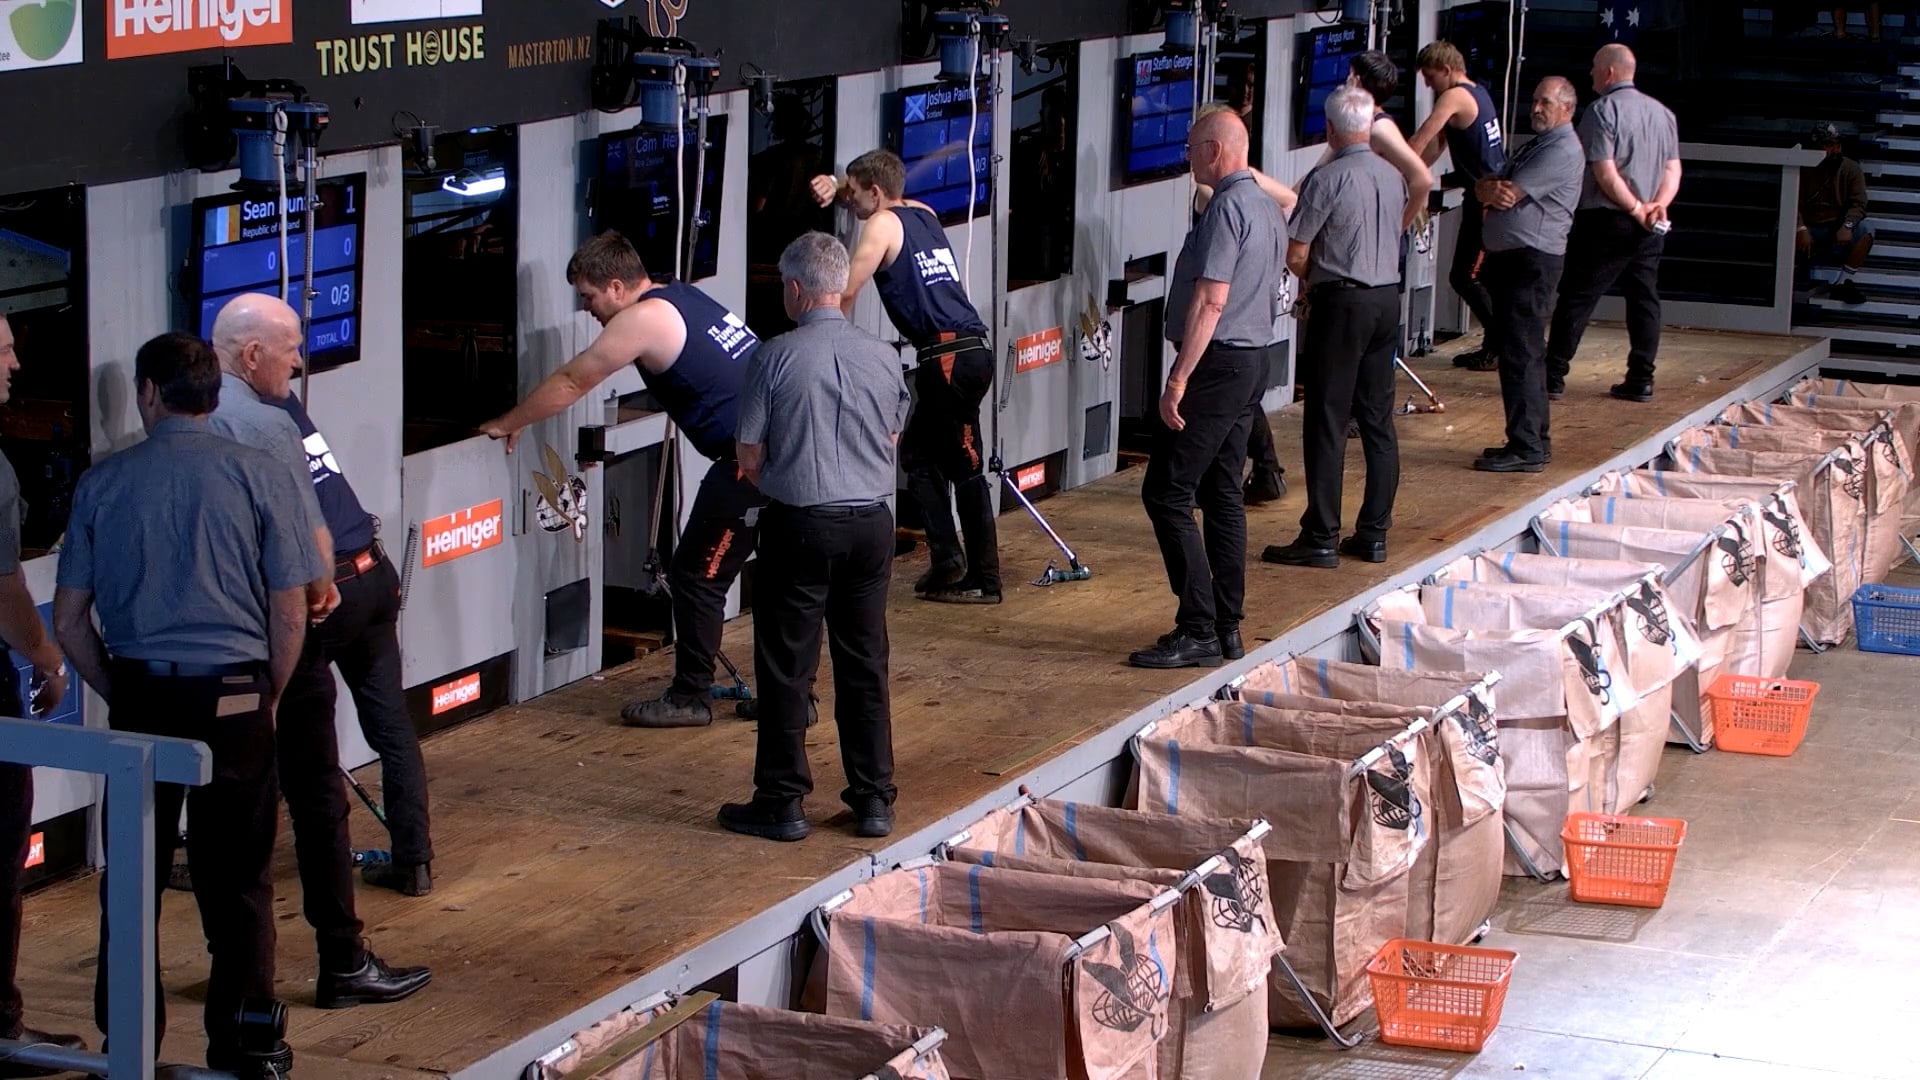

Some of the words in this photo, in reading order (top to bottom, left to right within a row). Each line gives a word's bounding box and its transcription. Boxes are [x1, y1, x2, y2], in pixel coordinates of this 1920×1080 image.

[114, 0, 280, 41] Heiniger
[315, 34, 396, 76] TRUST
[406, 25, 485, 66] HOUSE
[508, 35, 592, 69] MASTERTON.NZ
[1173, 54, 1193, 70] George
[926, 87, 951, 108] Joshua
[953, 86, 979, 103] Paintr
[635, 135, 657, 153] Cam
[975, 156, 986, 174] 0/3
[243, 199, 275, 221] Sean
[345, 185, 356, 213] 1
[242, 222, 269, 238] Republic
[270, 223, 278, 234] of
[343, 237, 352, 256] 0
[267, 250, 276, 270] 0
[331, 283, 350, 306] 0/3
[316, 331, 339, 346] TOTAL
[340, 318, 350, 341] 0
[1018, 331, 1062, 366] Heiniger
[426, 508, 501, 558] Heiniger
[706, 528, 735, 578] Heiniger
[433, 679, 480, 709] Heiniger
